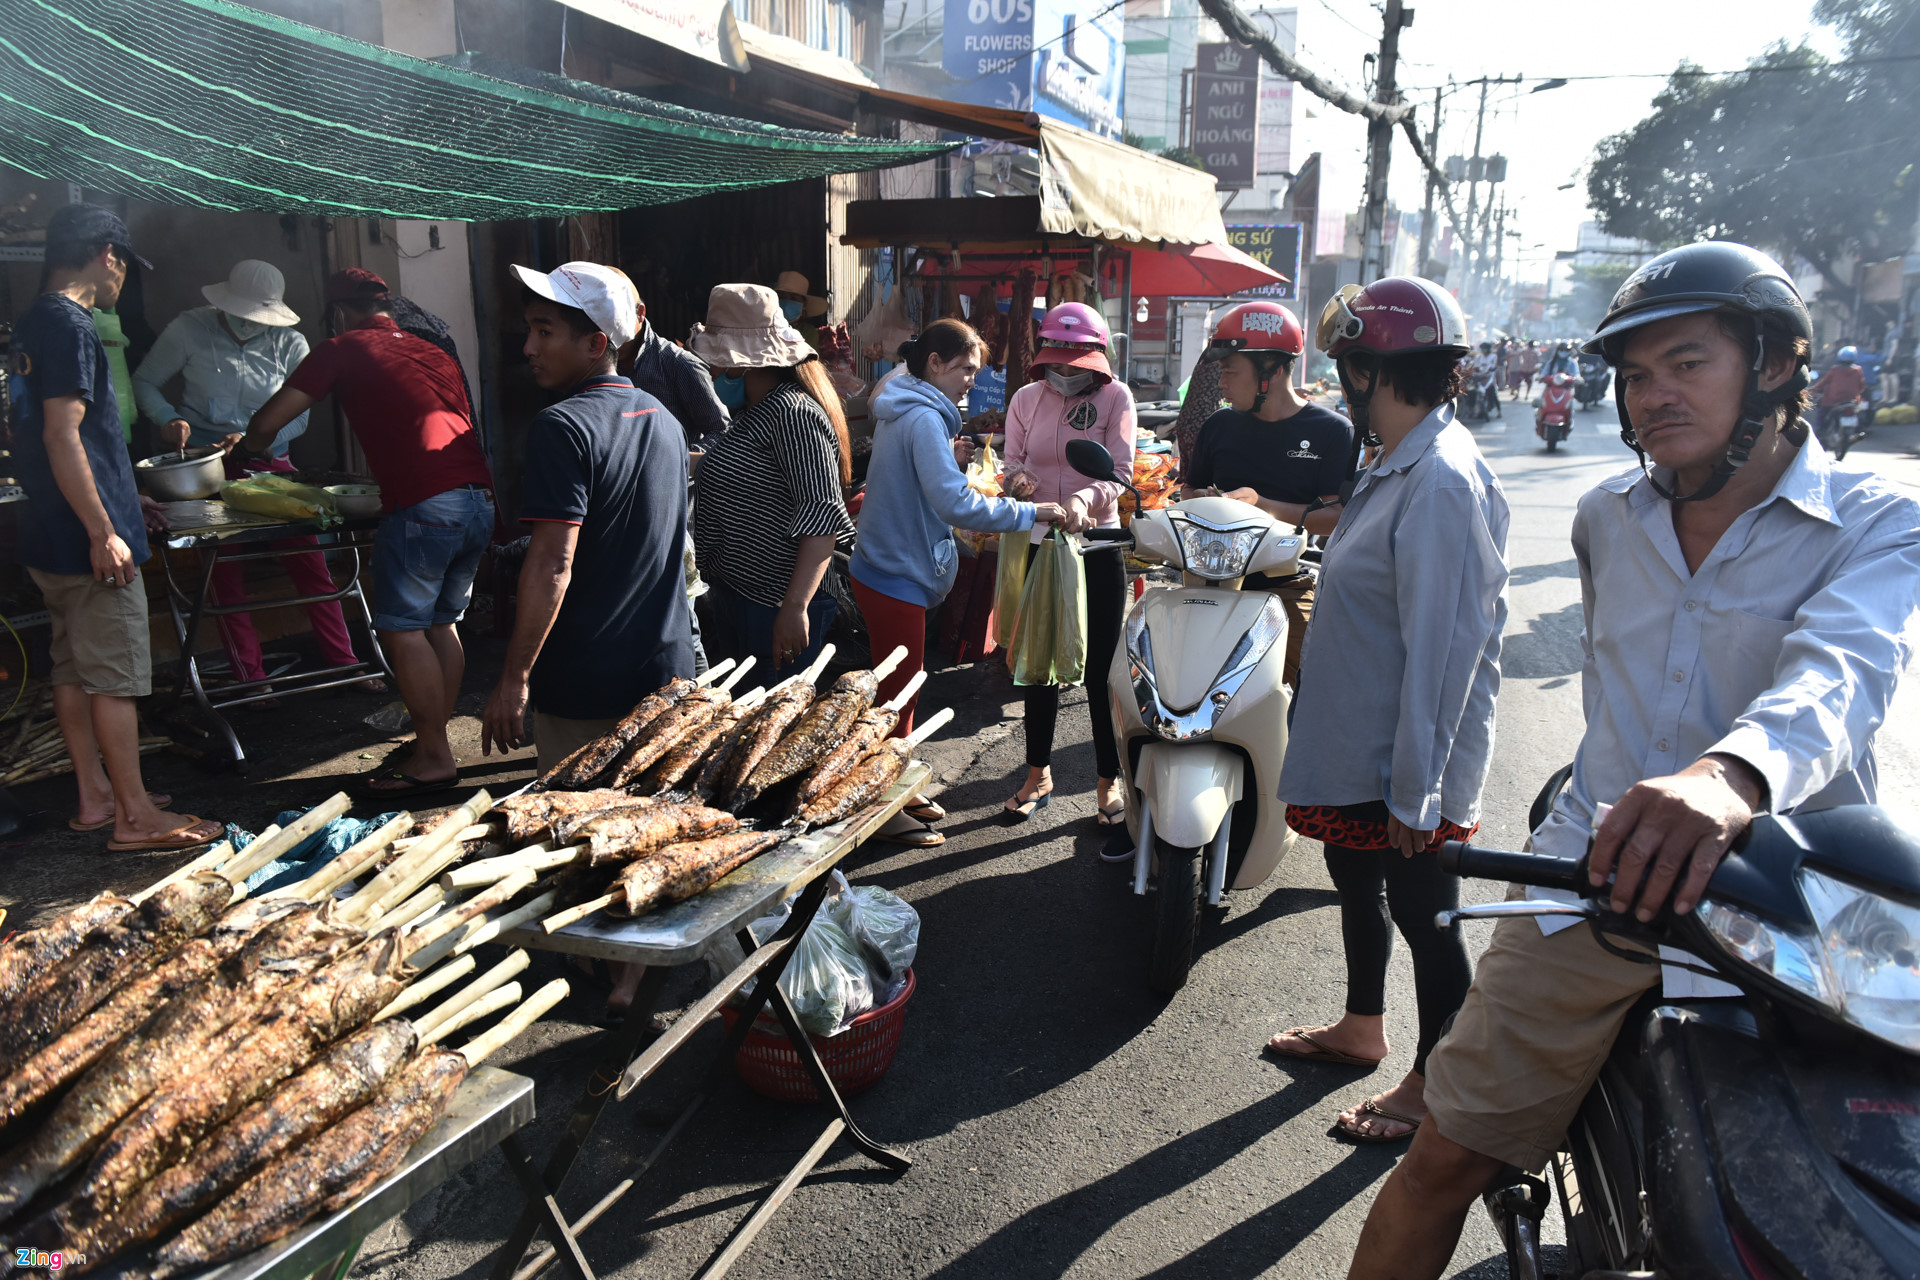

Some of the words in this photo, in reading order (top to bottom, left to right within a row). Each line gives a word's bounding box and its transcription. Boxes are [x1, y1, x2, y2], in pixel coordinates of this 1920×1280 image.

[965, 34, 1032, 51] FLOWERS
[977, 58, 1017, 74] SHOP
[1208, 81, 1246, 96] ANH
[1207, 101, 1245, 119] NGỮ
[1207, 152, 1239, 167] GIA
[1250, 228, 1275, 245] SỨ
[1243, 312, 1284, 323] LINKIN
[1242, 319, 1282, 339] PARK
[986, 395, 1002, 405] Hoa
[1845, 1098, 1920, 1116] HON
